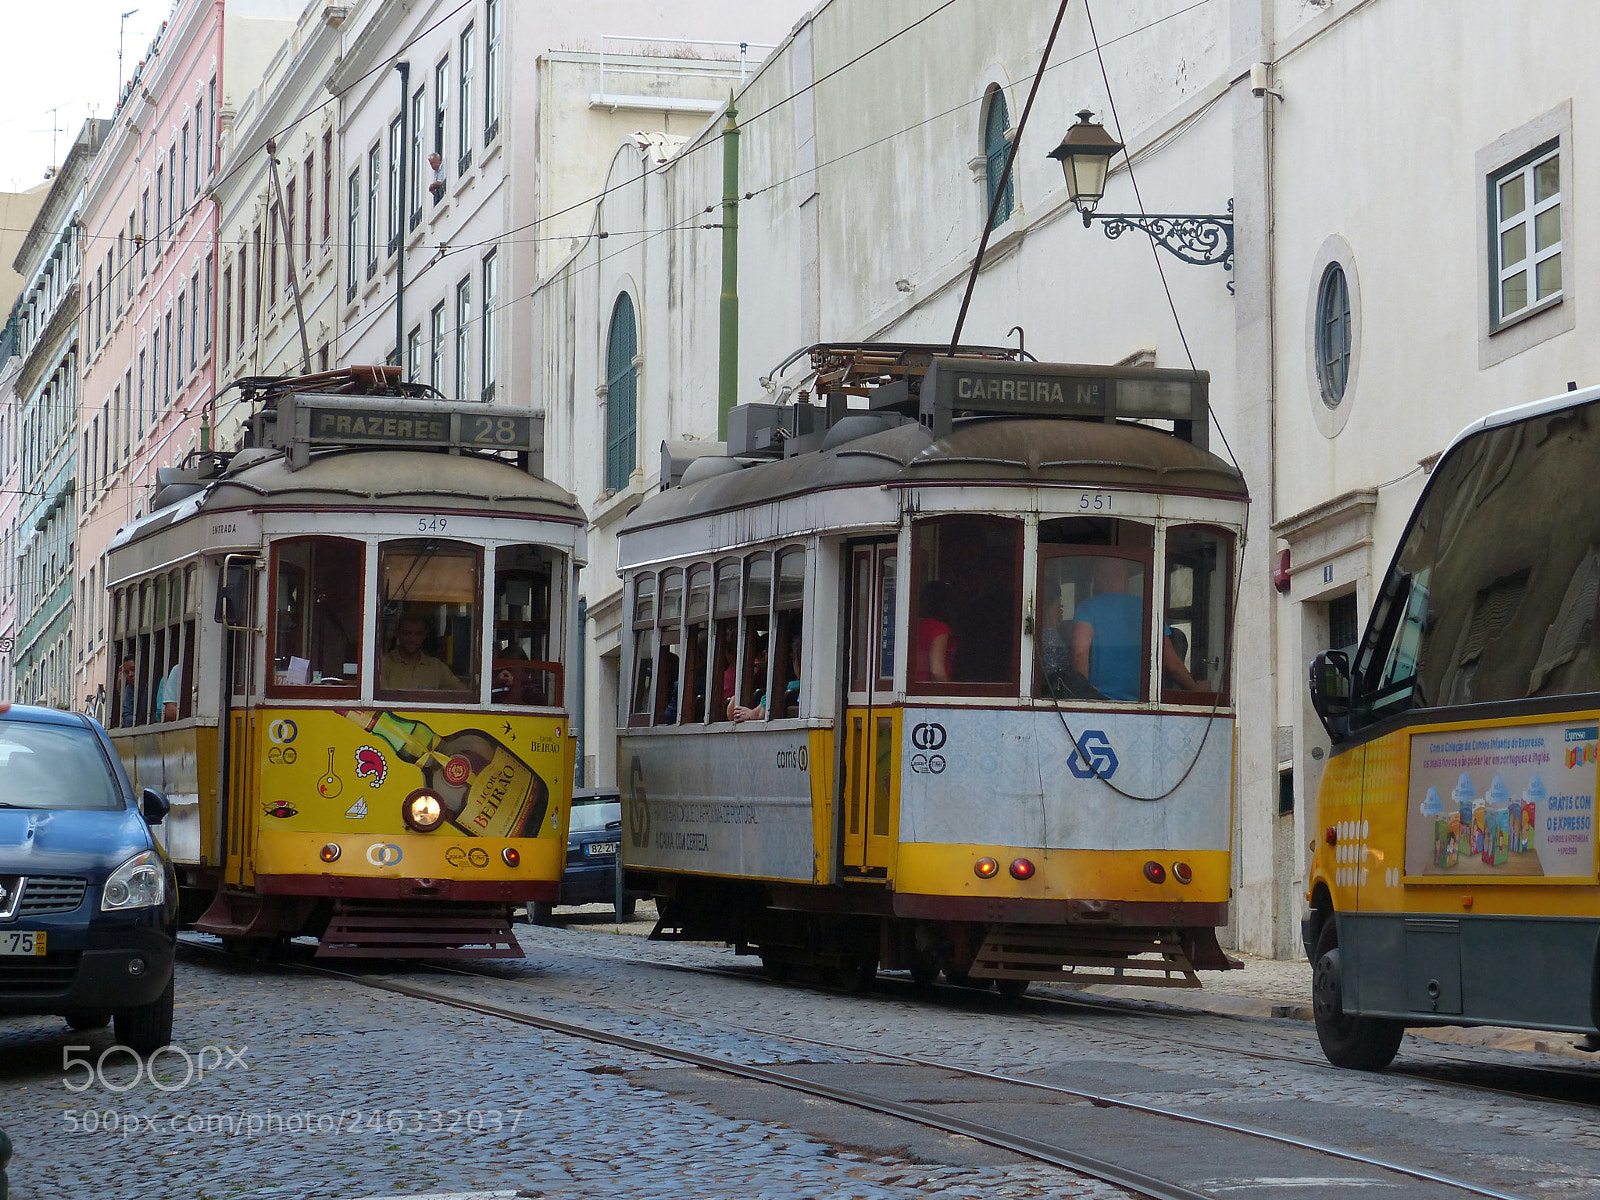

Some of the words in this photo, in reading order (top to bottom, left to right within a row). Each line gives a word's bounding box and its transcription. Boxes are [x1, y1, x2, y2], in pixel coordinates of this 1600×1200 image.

[958, 377, 1064, 403] CARREIRA
[320, 414, 443, 439] PRAZERES
[474, 417, 516, 444] 28
[1079, 494, 1113, 510] 551
[212, 523, 237, 535] ENTRADA
[418, 518, 447, 532] 549
[531, 741, 560, 753] BEIRÃO
[776, 743, 797, 769] carris
[473, 765, 515, 829] BEIRÃO
[476, 775, 497, 805] LICOR
[1549, 792, 1573, 811] GRÁTIS
[1575, 795, 1591, 810] COM
[1547, 817, 1552, 831] O
[1553, 815, 1591, 831] EXPRESSO
[37, 933, 45, 941] 07
[37, 946, 45, 954] 10
